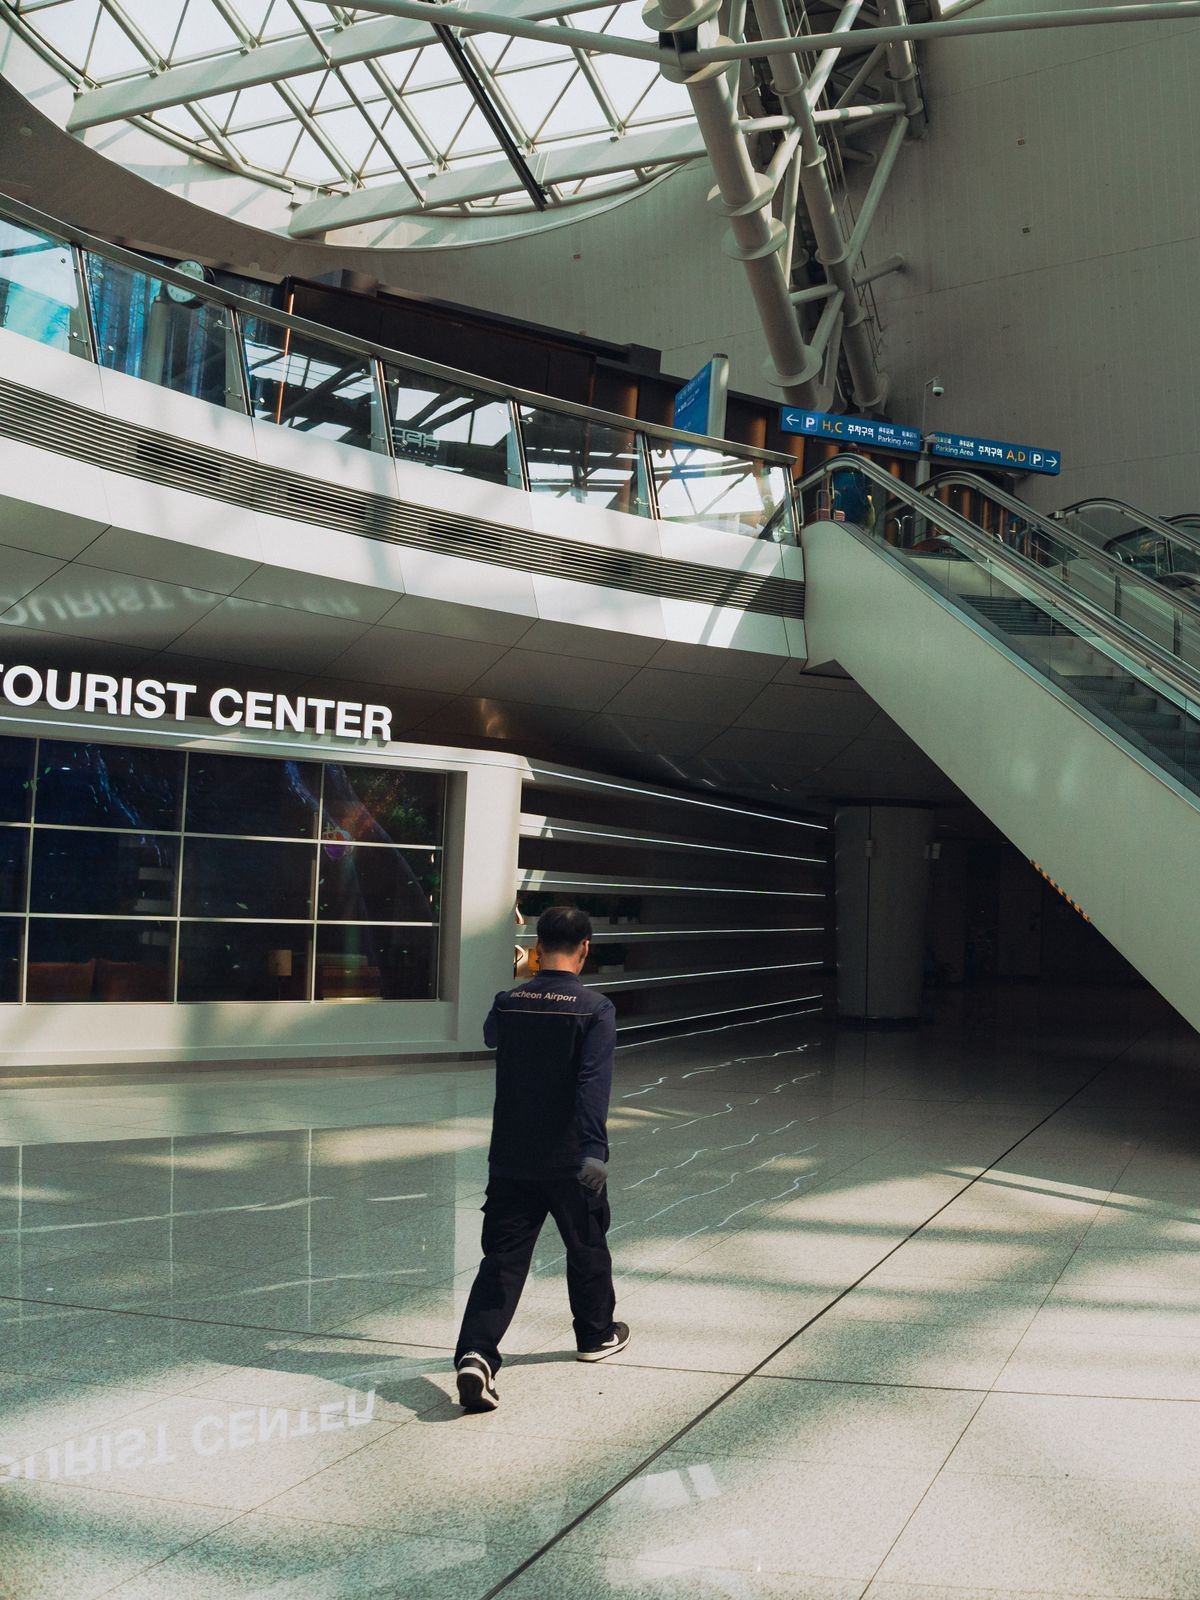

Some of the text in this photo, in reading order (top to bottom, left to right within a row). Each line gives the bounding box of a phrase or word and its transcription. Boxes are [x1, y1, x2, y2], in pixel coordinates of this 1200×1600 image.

[805, 416, 815, 428] P
[822, 420, 843, 433] H,C
[847, 424, 875, 438] 주차구역
[877, 434, 901, 447] Parking
[935, 443, 958, 456] Parking
[959, 448, 974, 457] Area
[977, 445, 1042, 465] 주차구역 A,D P
[0, 663, 393, 742] OURIST CENTER
[510, 990, 577, 1003] Incheon Airport
